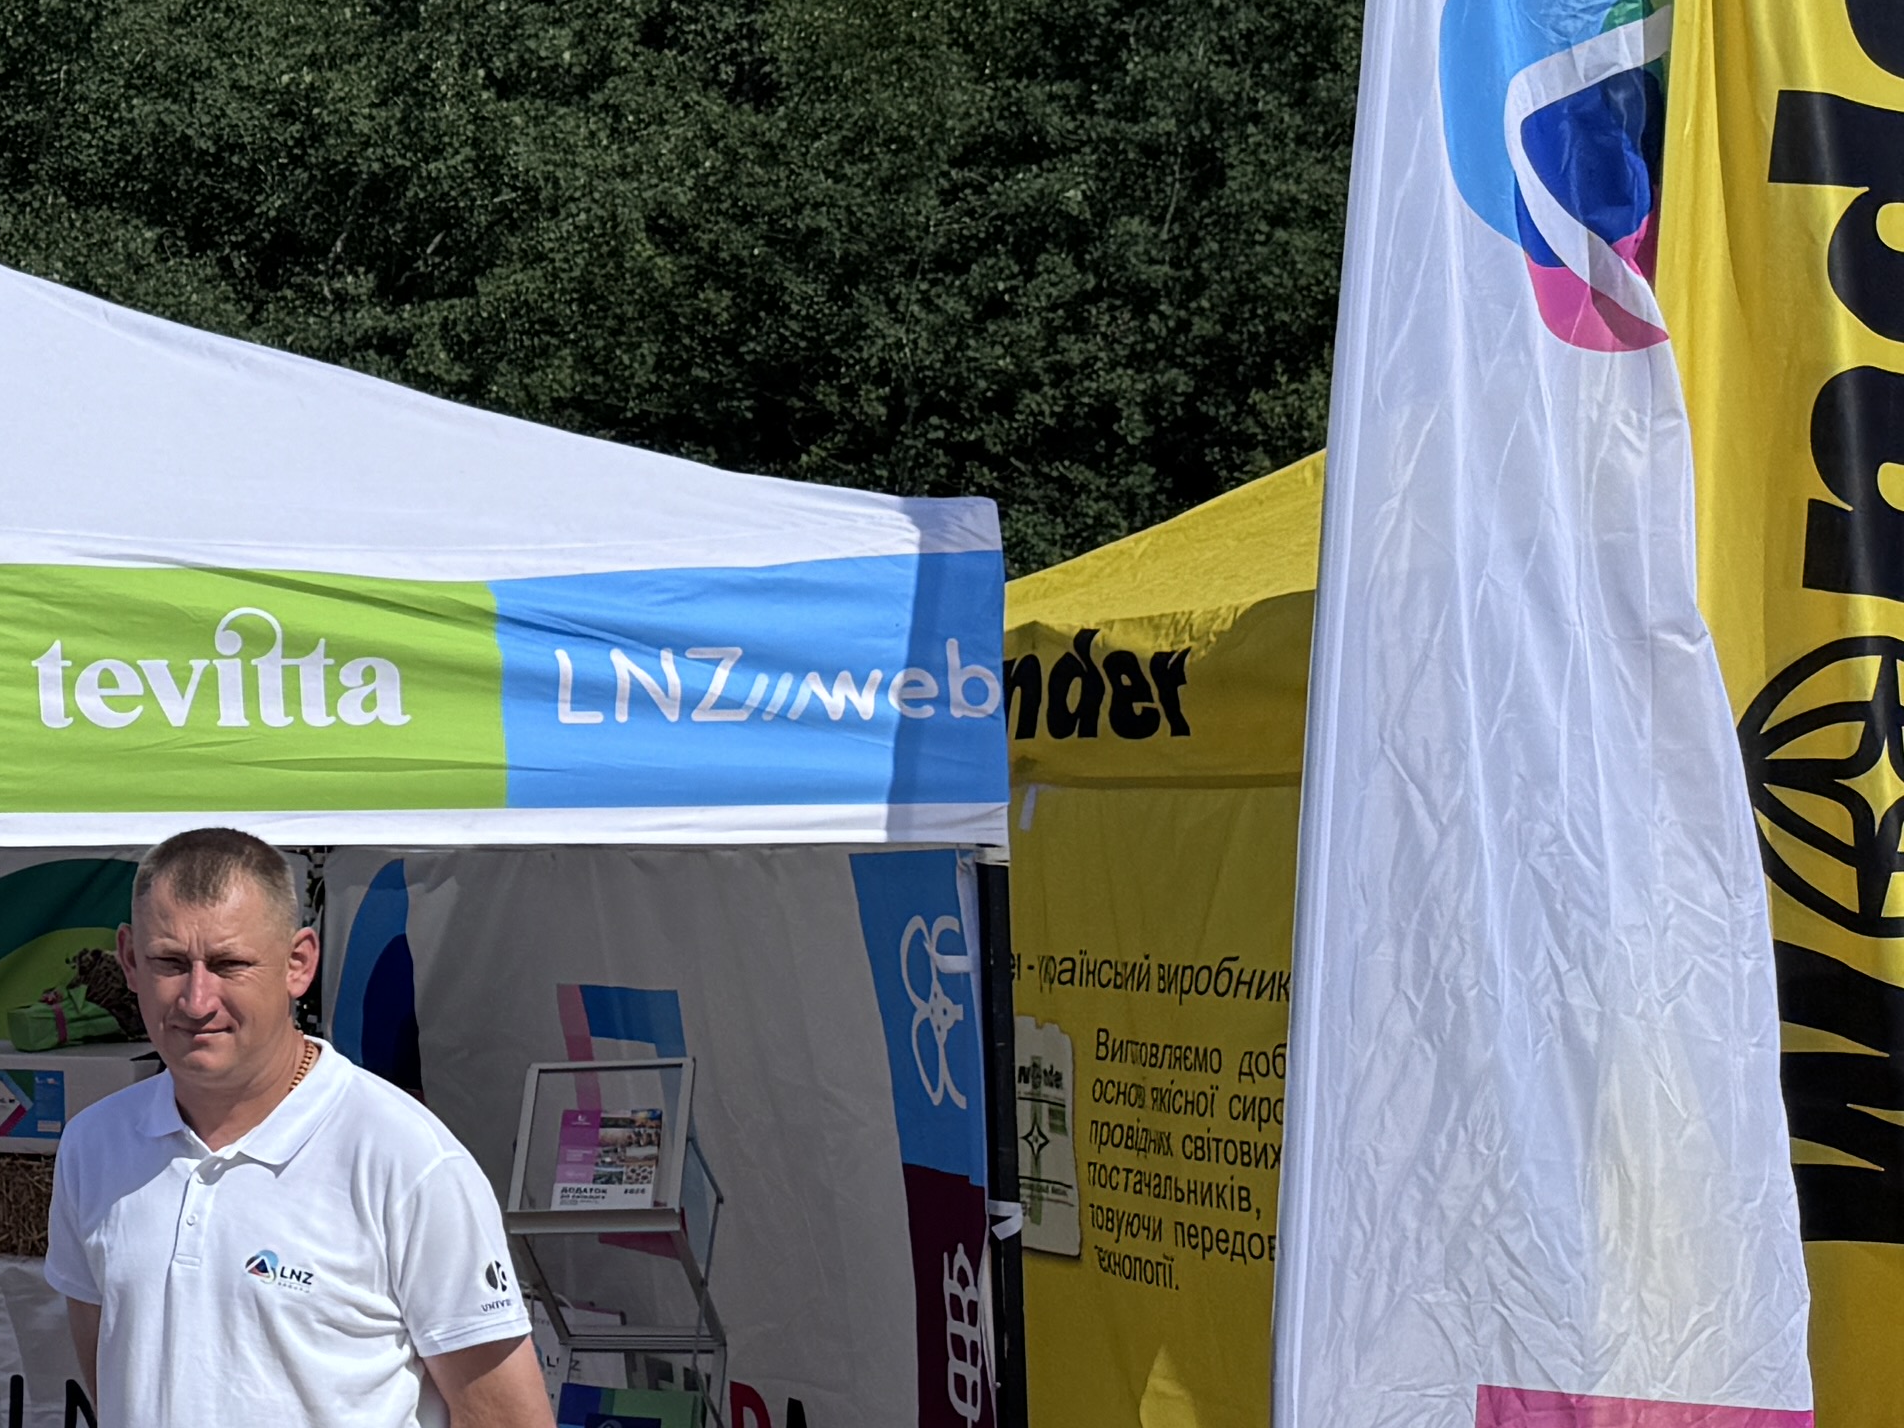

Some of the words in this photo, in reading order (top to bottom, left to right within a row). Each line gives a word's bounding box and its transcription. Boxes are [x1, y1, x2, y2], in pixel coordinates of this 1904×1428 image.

[31, 605, 411, 729] tevitta
[1004, 628, 1193, 741] nder
[1157, 955, 1290, 1006] виробник
[1237, 1042, 1287, 1084] доб
[1151, 1078, 1219, 1118] якісної
[1228, 1093, 1285, 1132] сиро
[1089, 1117, 1174, 1160] провідних
[1181, 1127, 1281, 1170] світових
[1087, 1161, 1262, 1221] постачальників,
[1173, 1220, 1277, 1265] передов
[279, 1265, 314, 1285] LNZ
